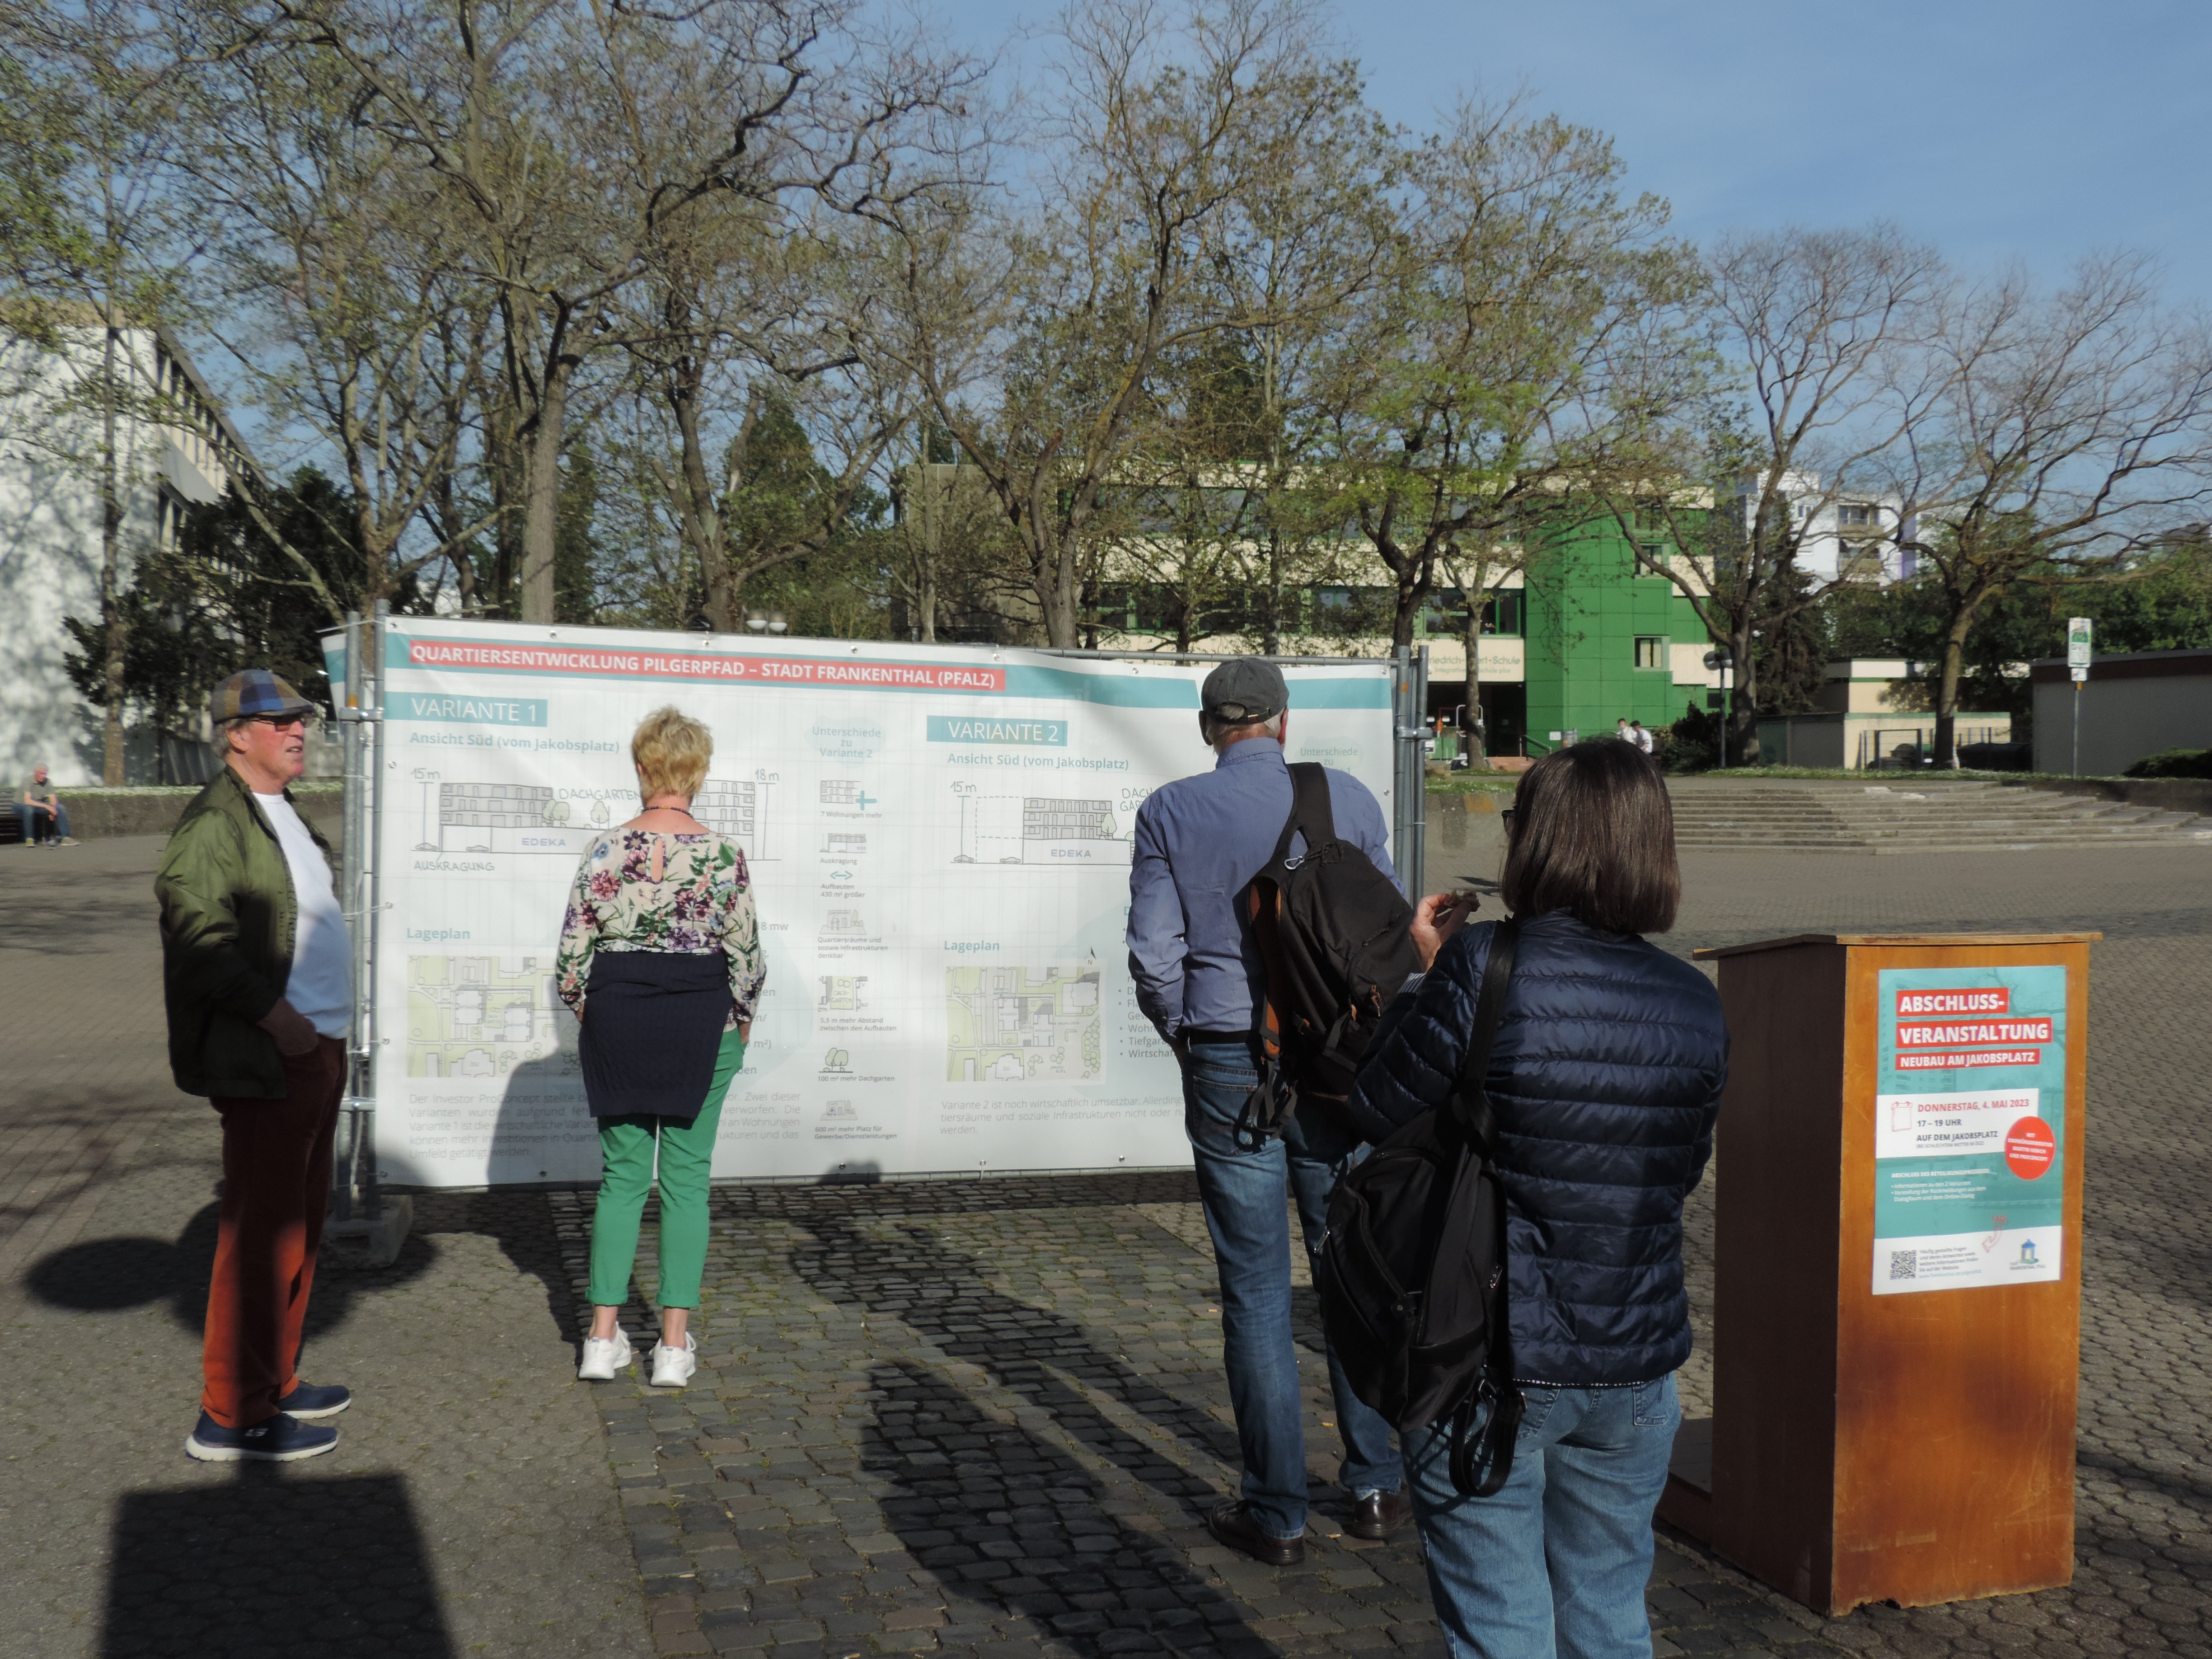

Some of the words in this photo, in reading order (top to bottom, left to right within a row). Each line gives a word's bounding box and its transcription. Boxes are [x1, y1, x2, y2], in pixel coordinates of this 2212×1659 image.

[412, 645, 639, 670] QUARTIERSENTWICKLUNG
[644, 657, 745, 675] PILGERPFAD
[762, 663, 813, 679] STADT
[818, 665, 934, 684] FRANKENTHAL
[938, 670, 995, 689] (PFALZ)
[411, 698, 520, 722] VARIANTE
[528, 705, 536, 722] 1
[812, 726, 881, 737] Unterschiede
[947, 722, 1042, 741] VARIANTE
[1048, 725, 1059, 742] 2
[410, 732, 464, 745] Ansicht
[467, 734, 492, 747] Süd
[497, 736, 531, 750] (vom
[534, 738, 620, 754] Jakobsplatz)
[820, 748, 863, 758] Variante
[1300, 747, 1358, 756] Unterschiede
[947, 753, 994, 764] Ansicht
[997, 754, 1020, 765] Süd
[1023, 756, 1054, 768] (vom
[1056, 757, 1129, 771] Jakobsplatz)
[825, 811, 864, 819] Wohnungen
[522, 837, 566, 847] EDEKA
[1051, 849, 1092, 858] EDEKA
[413, 861, 495, 872] AUSKRAGUNG
[407, 928, 470, 942] Lageplan
[944, 940, 1000, 953] Lageplan
[1899, 994, 2004, 1012] ABSCHLUSS-
[1899, 1023, 2048, 1044] VERANSTALTUNG
[1900, 1056, 1945, 1067] NEUBAU
[1947, 1055, 1964, 1065] AM
[1965, 1052, 2035, 1067] JAKOBSPLATZ
[409, 1094, 429, 1104] Der
[433, 1094, 474, 1104] Investor
[744, 1092, 767, 1101] Zwei
[771, 1092, 801, 1101] dieser
[941, 1101, 981, 1110] Variante
[983, 1100, 989, 1109] 2
[992, 1100, 1002, 1109] ist
[1004, 1099, 1027, 1108] noch
[1030, 1098, 1088, 1108] wirtschaftlich
[1091, 1097, 1140, 1106] umsetzbar.
[408, 1108, 461, 1117] Varianten
[724, 1105, 777, 1114] verworfen.
[784, 1105, 801, 1114] Die
[1917, 1101, 1980, 1112] DONNERSTAG,
[1982, 1101, 1989, 1109] 4.
[1992, 1100, 2007, 1108] MAI
[2010, 1099, 2029, 1107] 2023
[941, 1113, 992, 1122] tiersräume
[996, 1113, 1015, 1121] und
[1018, 1112, 1049, 1121] soziale
[1053, 1110, 1121, 1120] Infrastrukturen
[1125, 1109, 1146, 1118] nicht
[1150, 1108, 1171, 1117] oder
[409, 1122, 451, 1131] Variante
[741, 1118, 800, 1129] Wohnungen
[940, 1125, 978, 1134] werden.
[409, 1135, 448, 1146] können
[452, 1134, 479, 1144] mehr
[760, 1131, 779, 1139] und
[782, 1131, 799, 1139] das
[1951, 1130, 1998, 1142] JAKOBSPLATZ
[409, 1149, 447, 1159] Umfeld
[450, 1148, 489, 1161] getätigt
